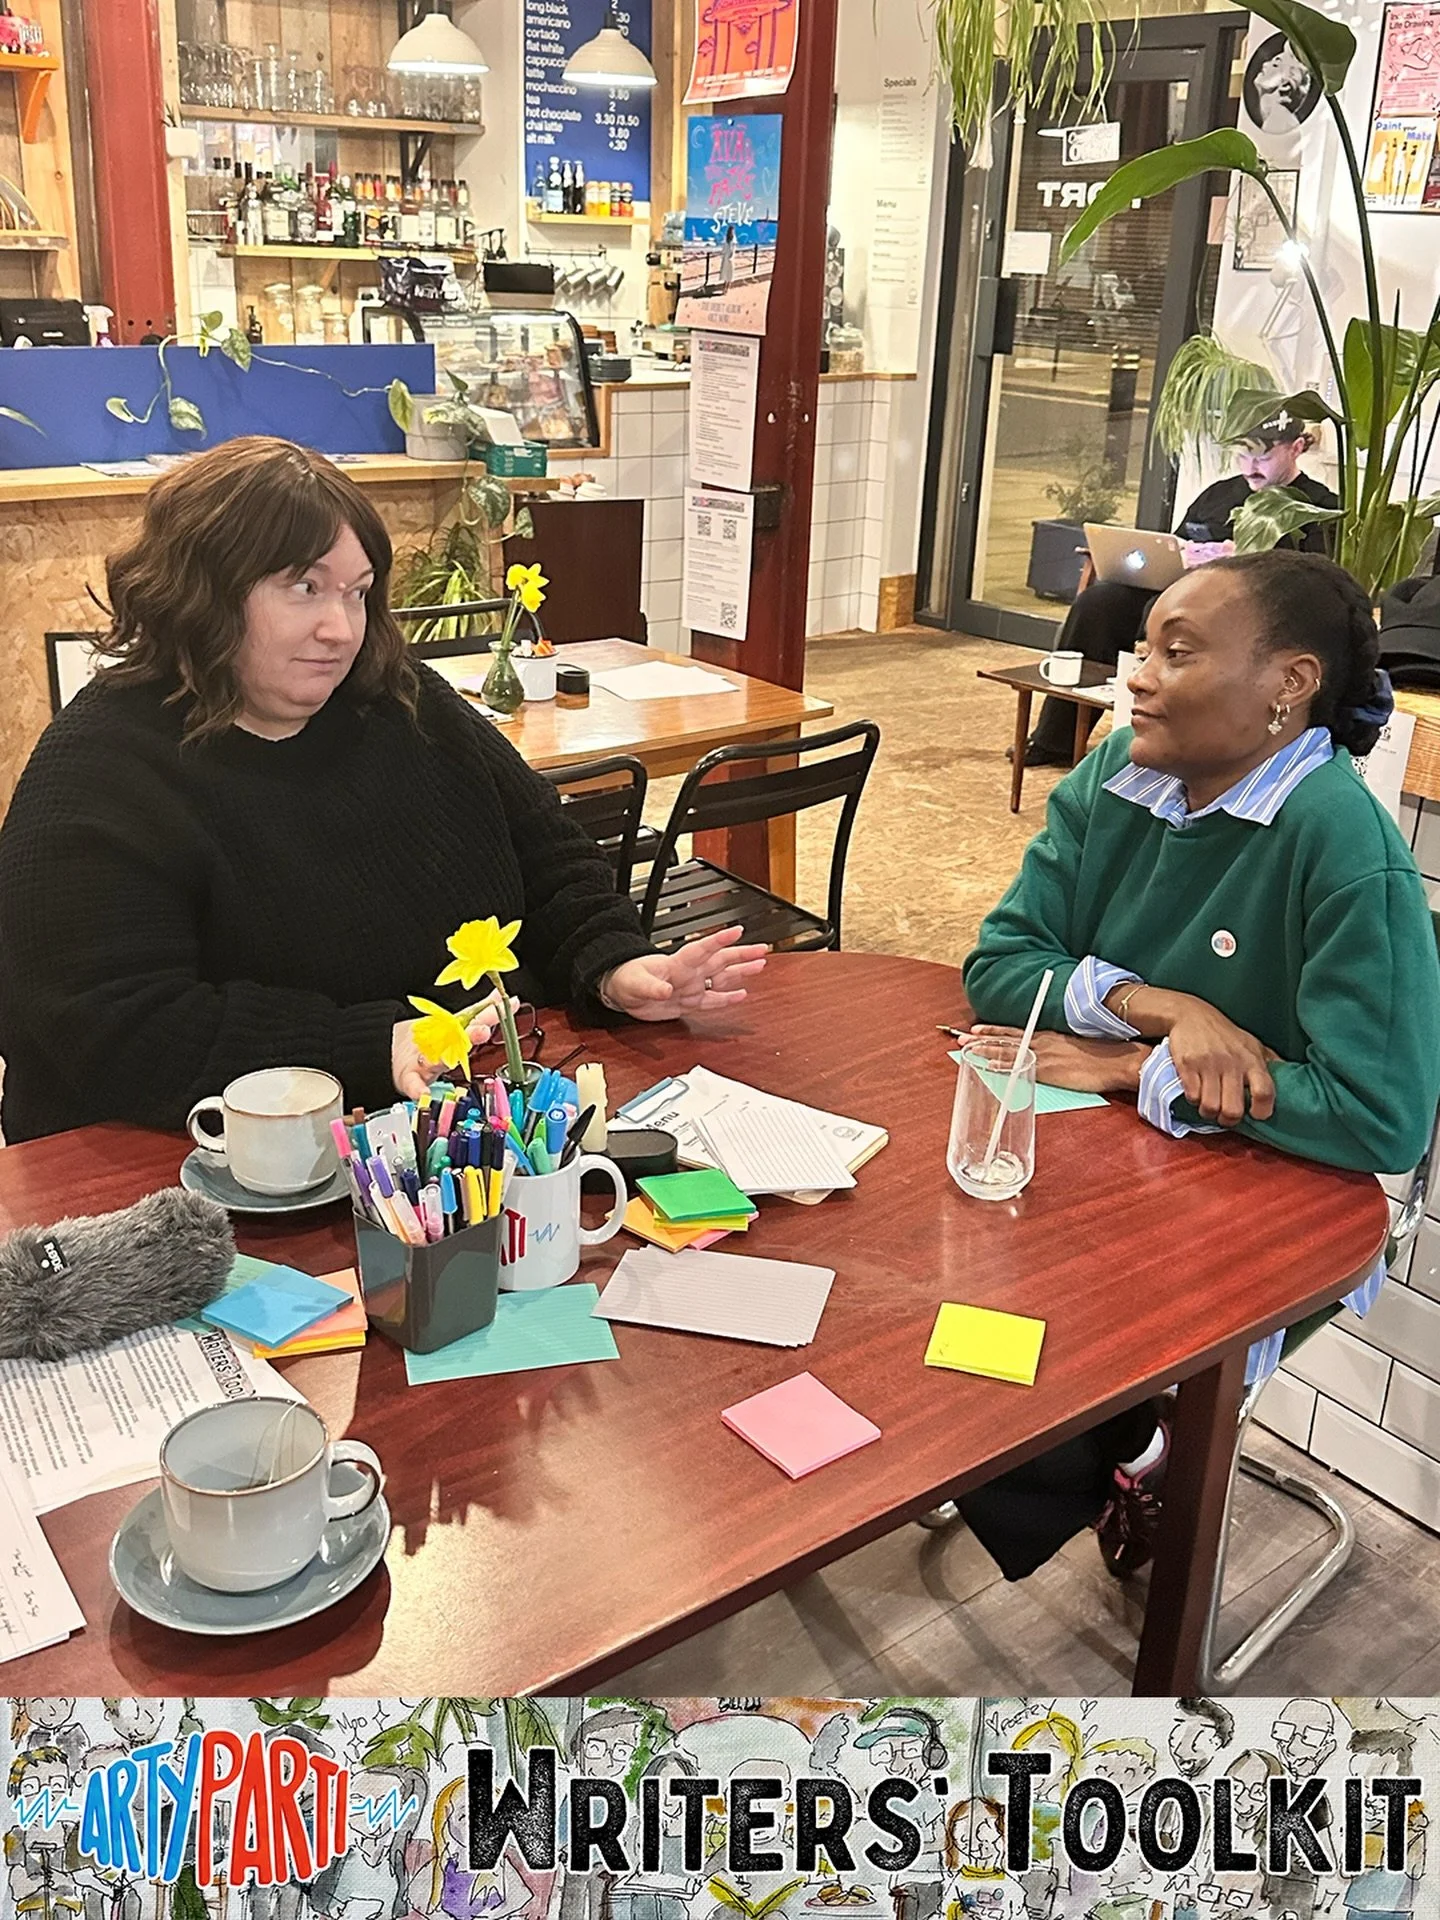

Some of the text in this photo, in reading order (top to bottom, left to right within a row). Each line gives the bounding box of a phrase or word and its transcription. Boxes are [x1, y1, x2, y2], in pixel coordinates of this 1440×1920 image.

[526, 0, 545, 14] long
[546, 5, 569, 15] black
[526, 15, 571, 29] americano
[1404, 20, 1434, 29] Drawing
[526, 28, 560, 41] cortado
[526, 40, 565, 55] flat white
[526, 55, 568, 68] cappuccin
[526, 66, 545, 79] latte
[526, 82, 577, 96] mochaccino
[884, 77, 917, 89] Specials
[526, 94, 616, 112] tea 2
[526, 106, 540, 118] hot
[541, 108, 582, 122] chocolate
[526, 119, 544, 131] chai
[545, 121, 563, 133] latte
[1375, 122, 1402, 131] Paint
[526, 133, 537, 144] alt
[538, 134, 556, 145] milk
[1406, 131, 1432, 141] Mate
[876, 199, 897, 209] Menu
